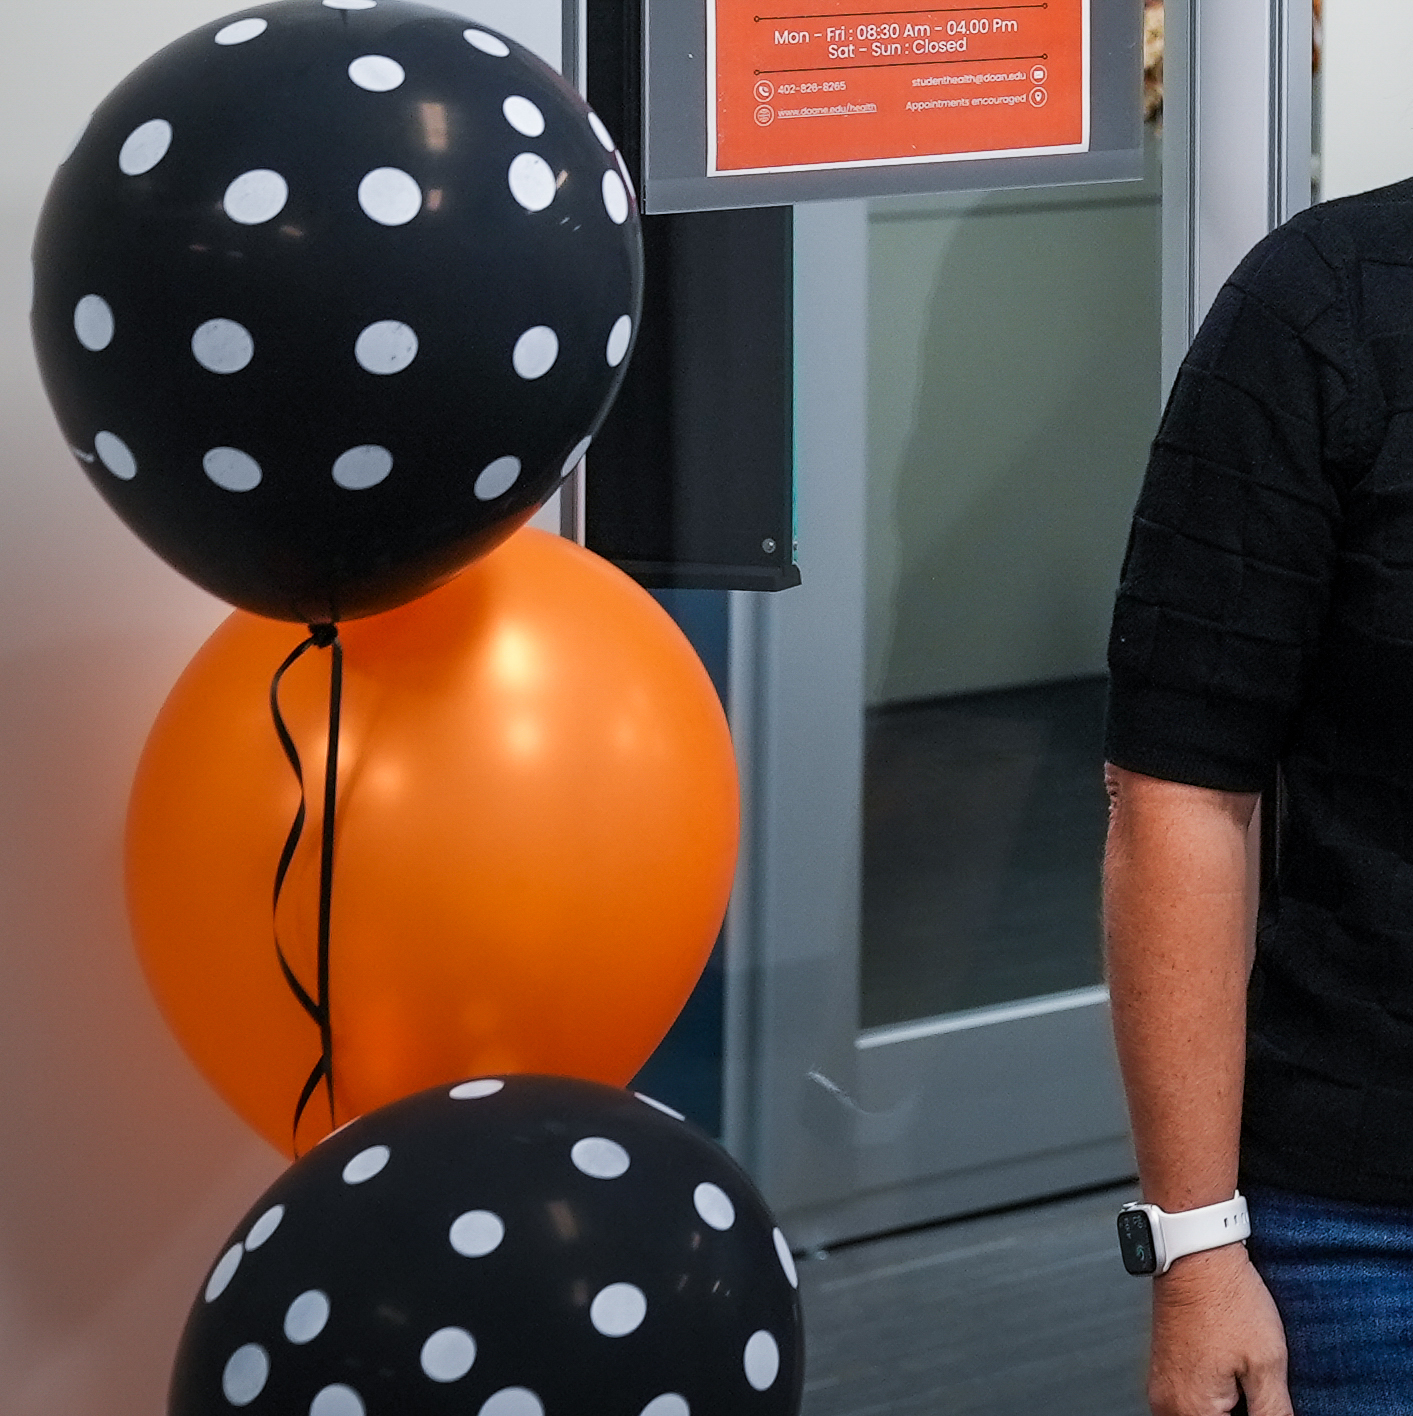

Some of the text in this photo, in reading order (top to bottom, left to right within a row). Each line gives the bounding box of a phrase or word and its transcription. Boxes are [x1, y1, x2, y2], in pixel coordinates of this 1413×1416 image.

[774, 29, 809, 44] Mon
[827, 26, 845, 41] Fri
[857, 23, 899, 40] 08:30
[903, 23, 930, 37] Am
[947, 19, 988, 35] 04.00
[993, 18, 1018, 32] Pm
[828, 43, 855, 58] Sat
[872, 42, 902, 56] Sun
[912, 36, 967, 54] Closed
[905, 93, 1027, 112] Appointments encouraged
